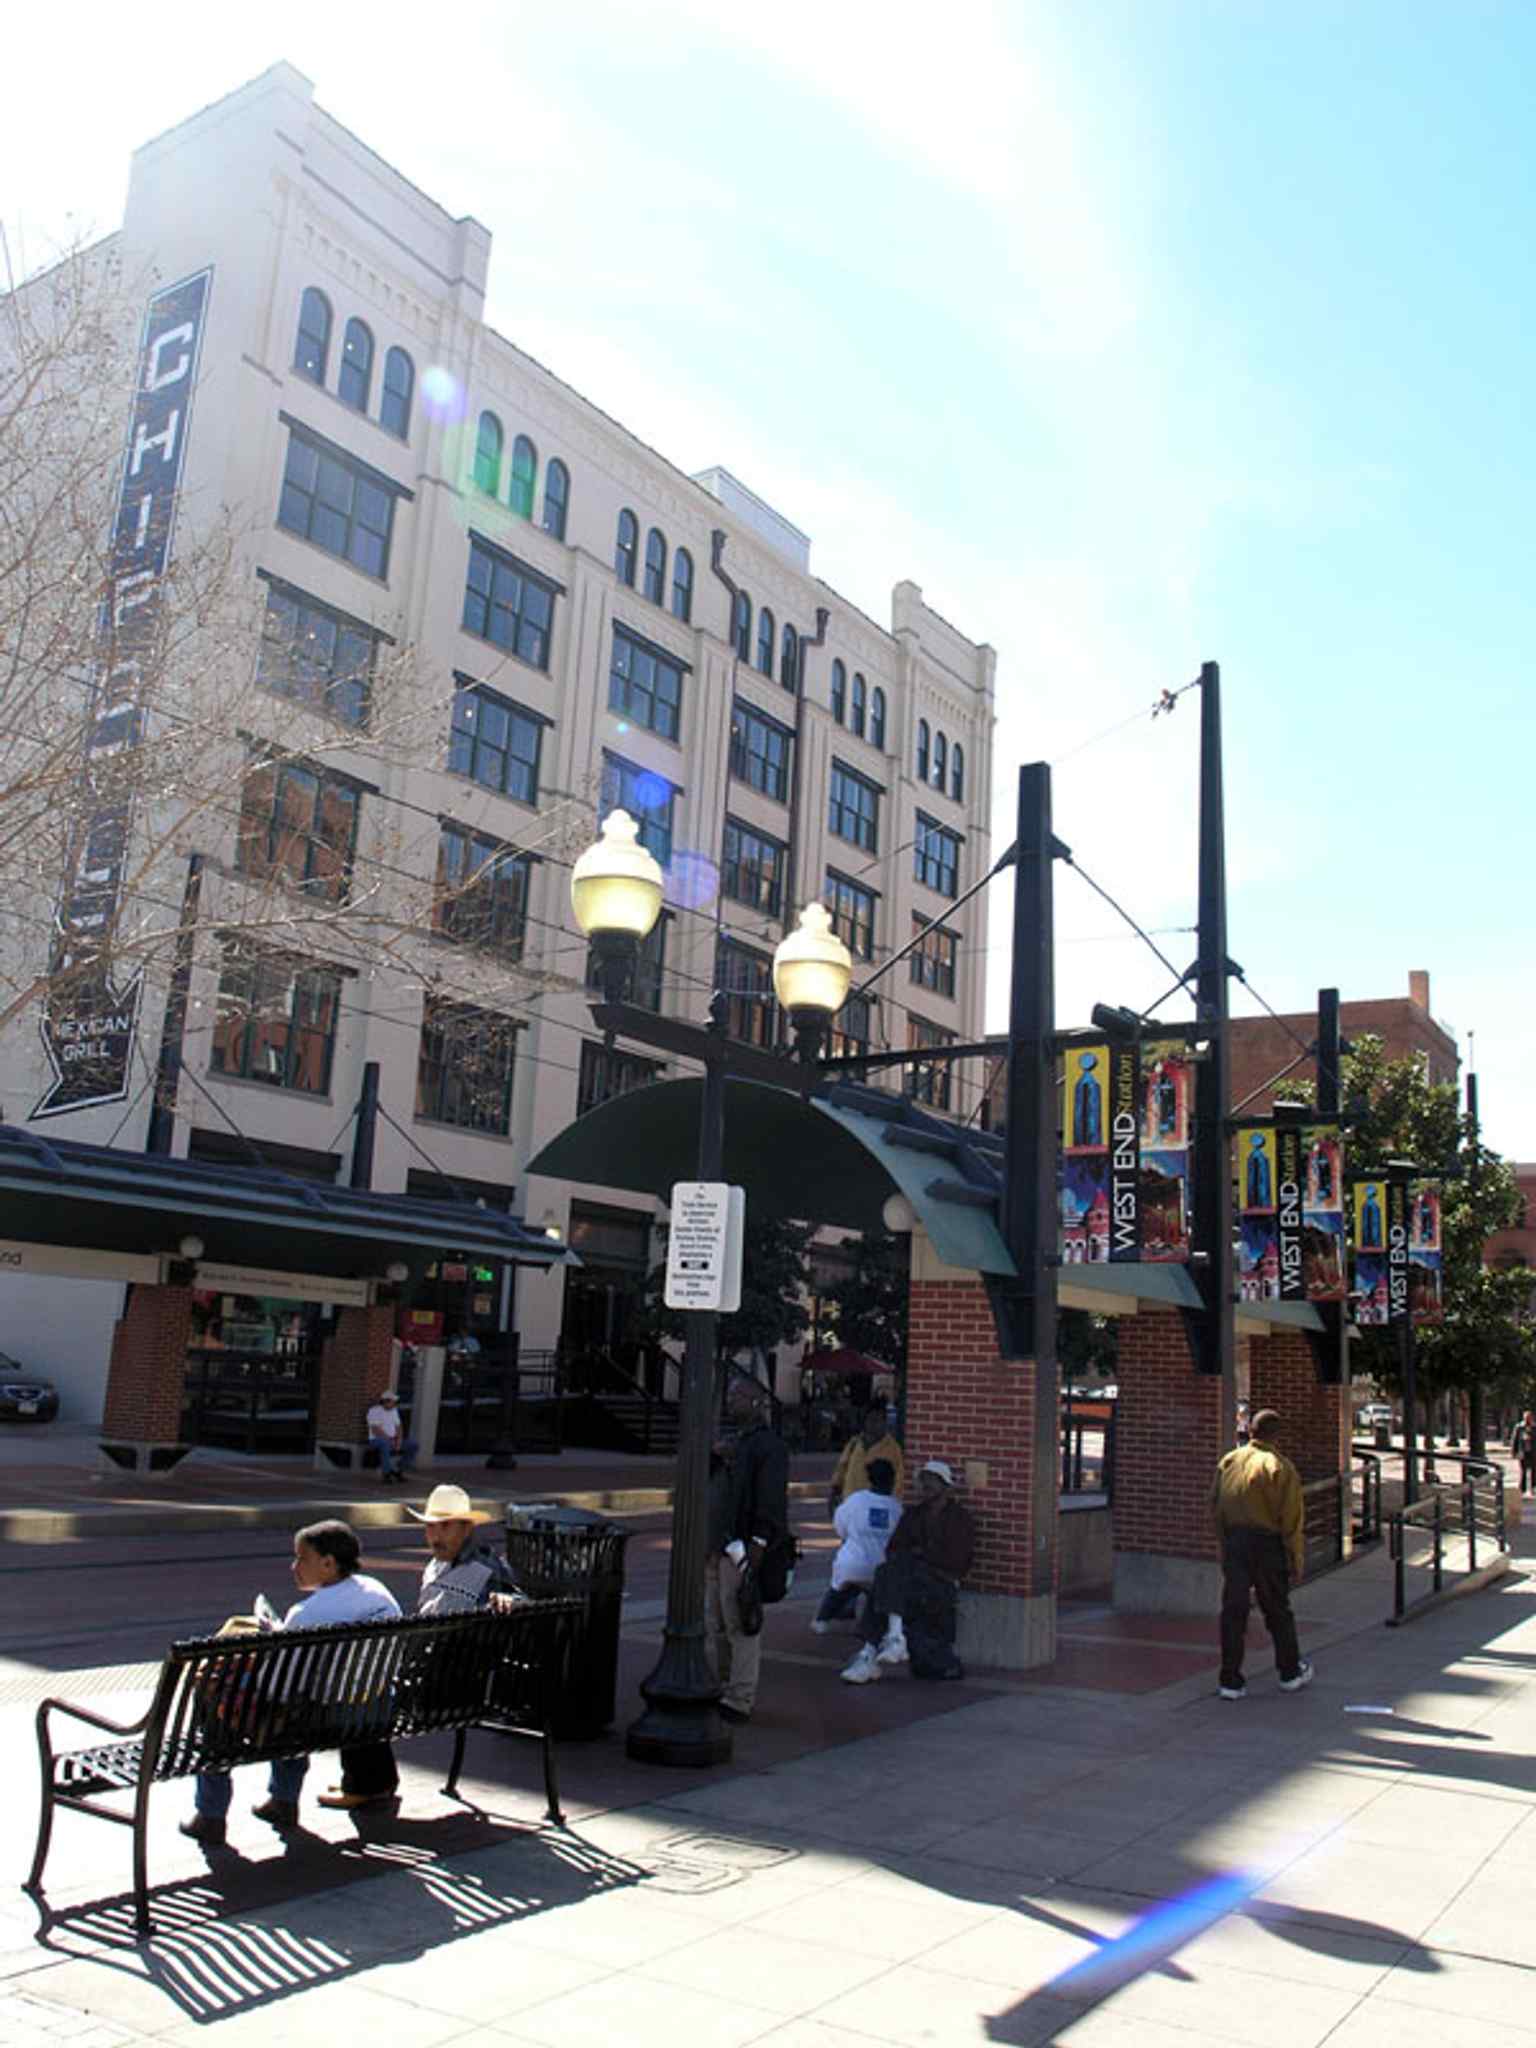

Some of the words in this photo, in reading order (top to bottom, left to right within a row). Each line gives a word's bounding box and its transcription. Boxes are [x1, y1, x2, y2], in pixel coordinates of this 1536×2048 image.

[63, 320, 194, 968] CHIPOL
[63, 1040, 112, 1061] GRILL
[1112, 1112, 1136, 1170] END
[1112, 1176, 1137, 1251] WEST
[1279, 1182, 1300, 1228] END
[1280, 1230, 1301, 1292] WEST
[1389, 1224, 1408, 1264] END
[1389, 1266, 1408, 1317] WEST
